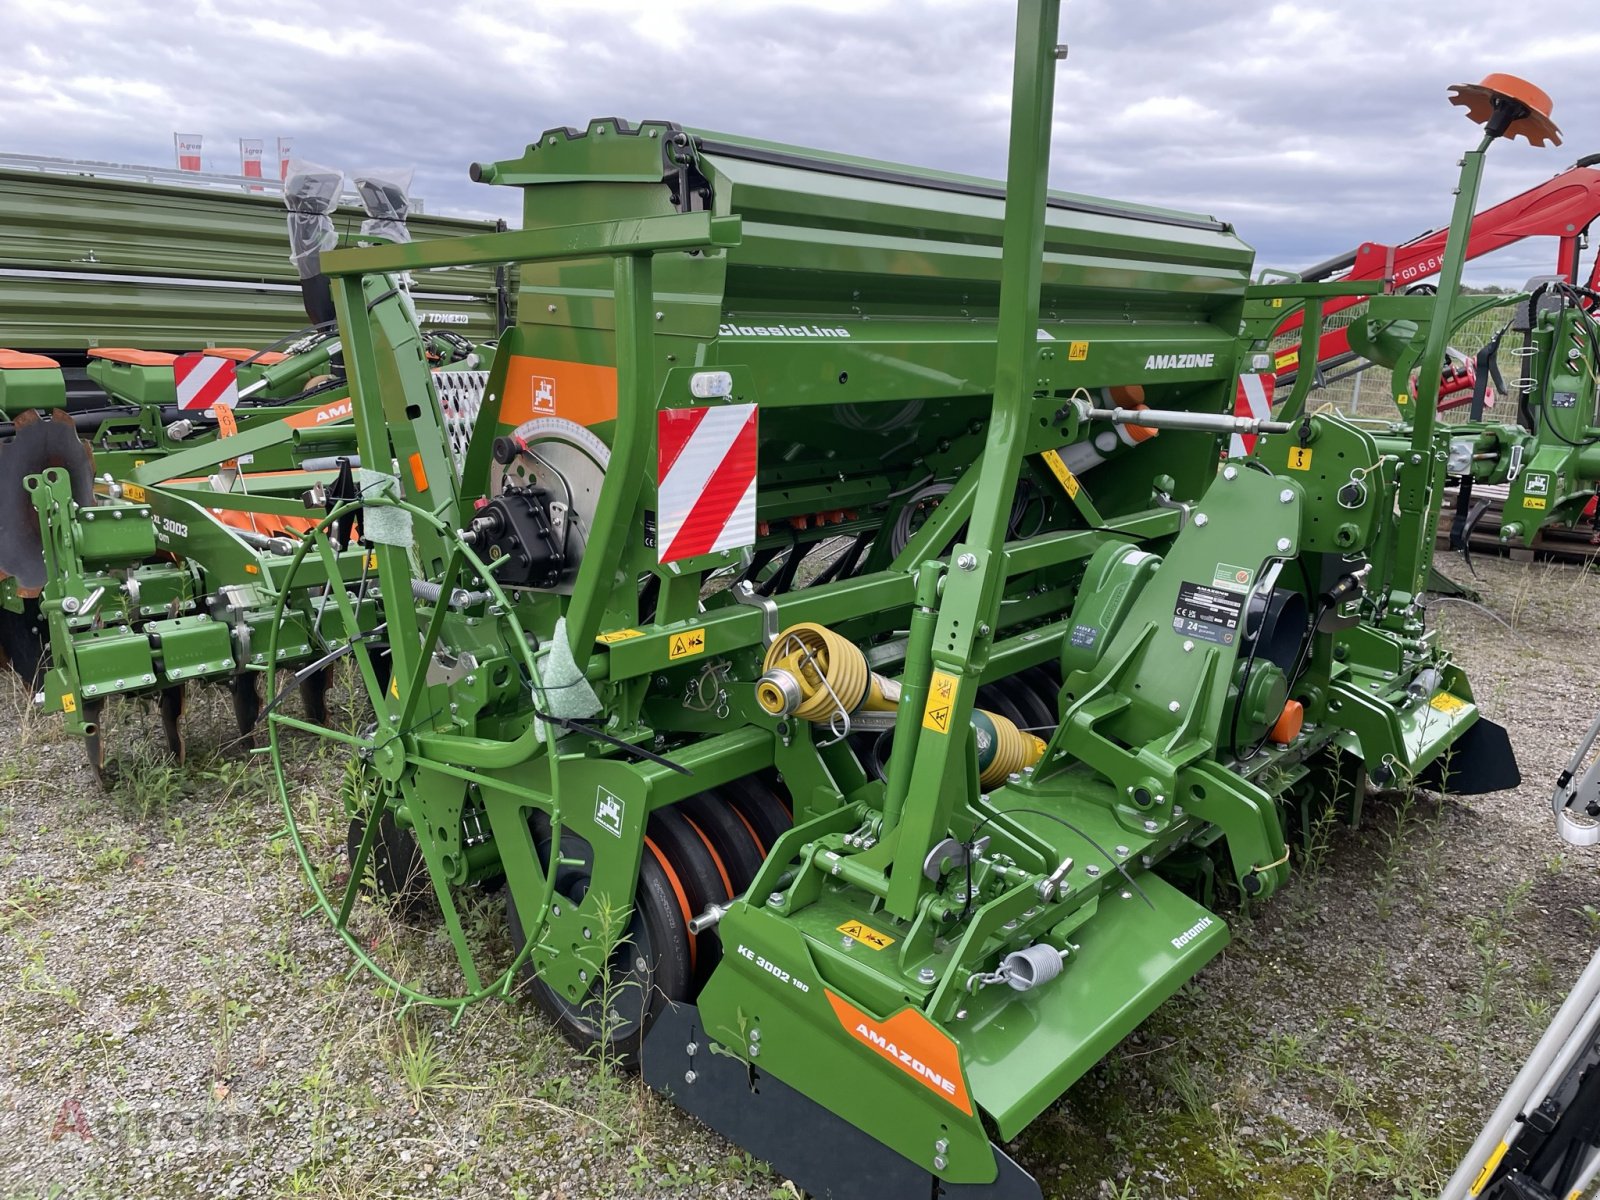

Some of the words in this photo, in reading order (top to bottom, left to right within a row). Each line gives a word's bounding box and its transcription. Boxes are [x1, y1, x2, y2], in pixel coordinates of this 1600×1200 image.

[1401, 267, 1417, 279] GD
[719, 323, 850, 337] ClassicLine
[1144, 353, 1214, 369] AMAZONE
[163, 518, 188, 537] 3003
[1187, 621, 1198, 631] 24
[737, 944, 755, 960] KE
[756, 956, 790, 983] 3002
[856, 1023, 956, 1095] AMAZONE
